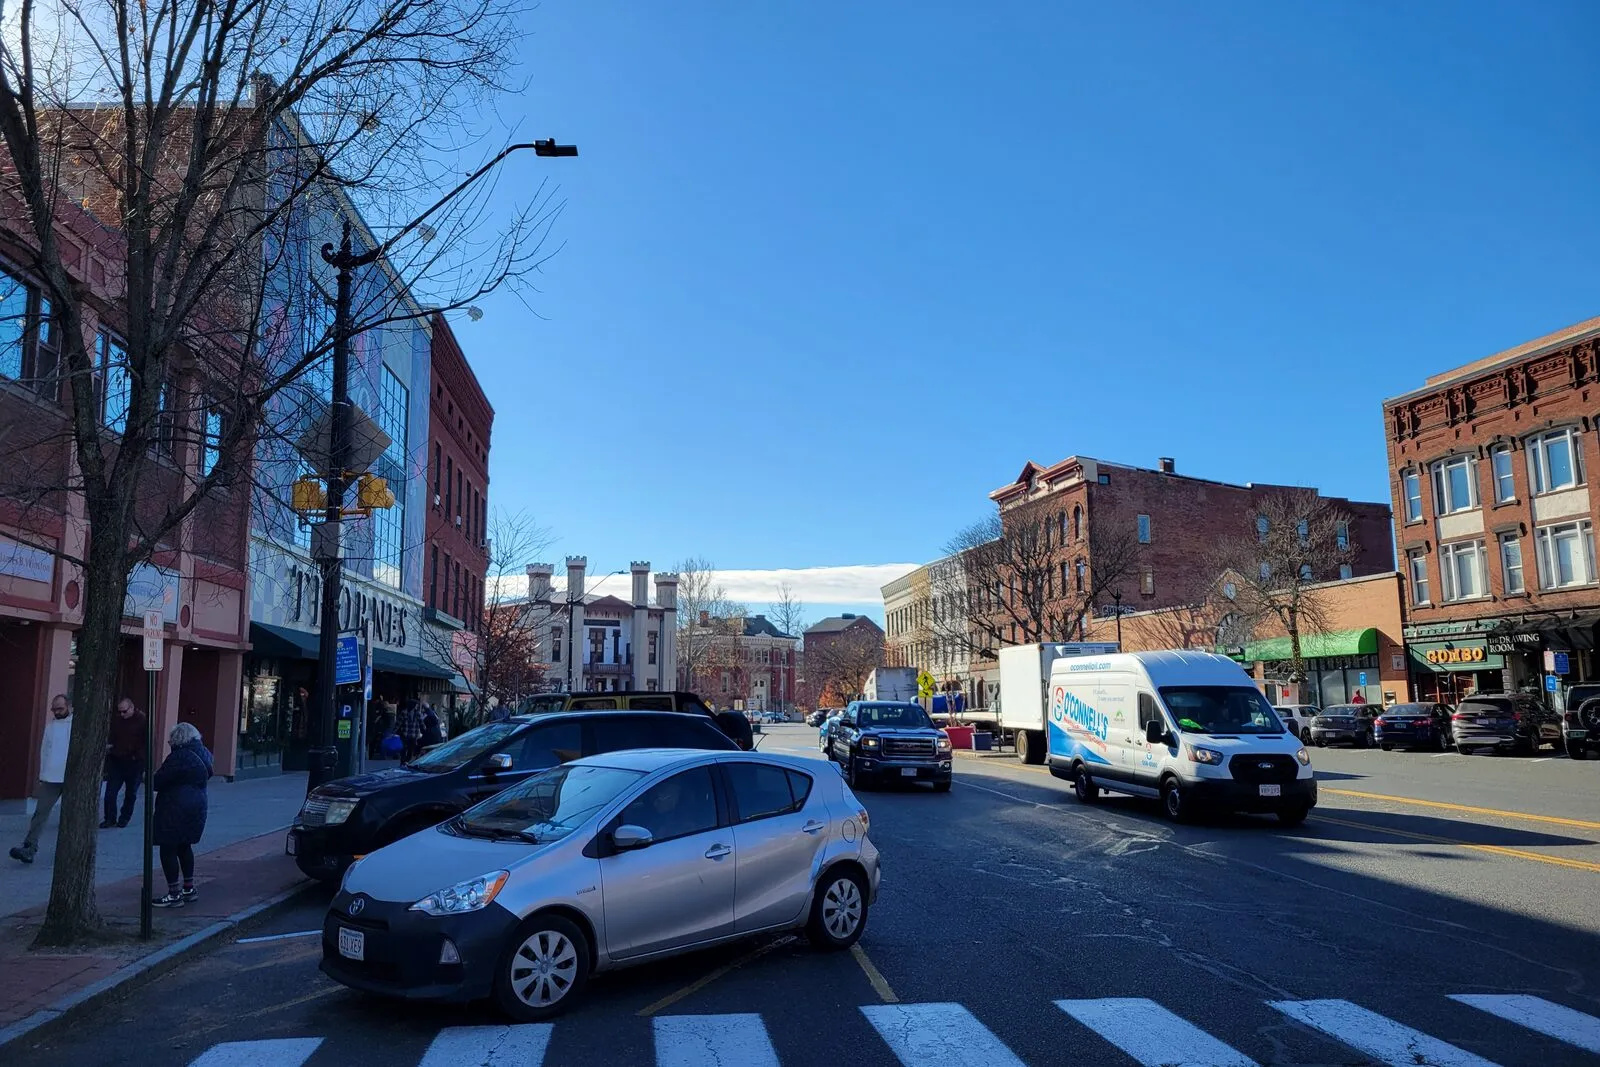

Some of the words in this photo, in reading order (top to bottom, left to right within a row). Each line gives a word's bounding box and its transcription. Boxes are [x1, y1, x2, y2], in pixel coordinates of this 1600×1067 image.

[149, 615, 158, 626] NO
[145, 629, 163, 639] PARKING
[1499, 633, 1540, 644] DRAWING
[1489, 643, 1515, 653] ROOM
[343, 704, 352, 717] P
[1064, 691, 1109, 741] O'CONNELL'S
